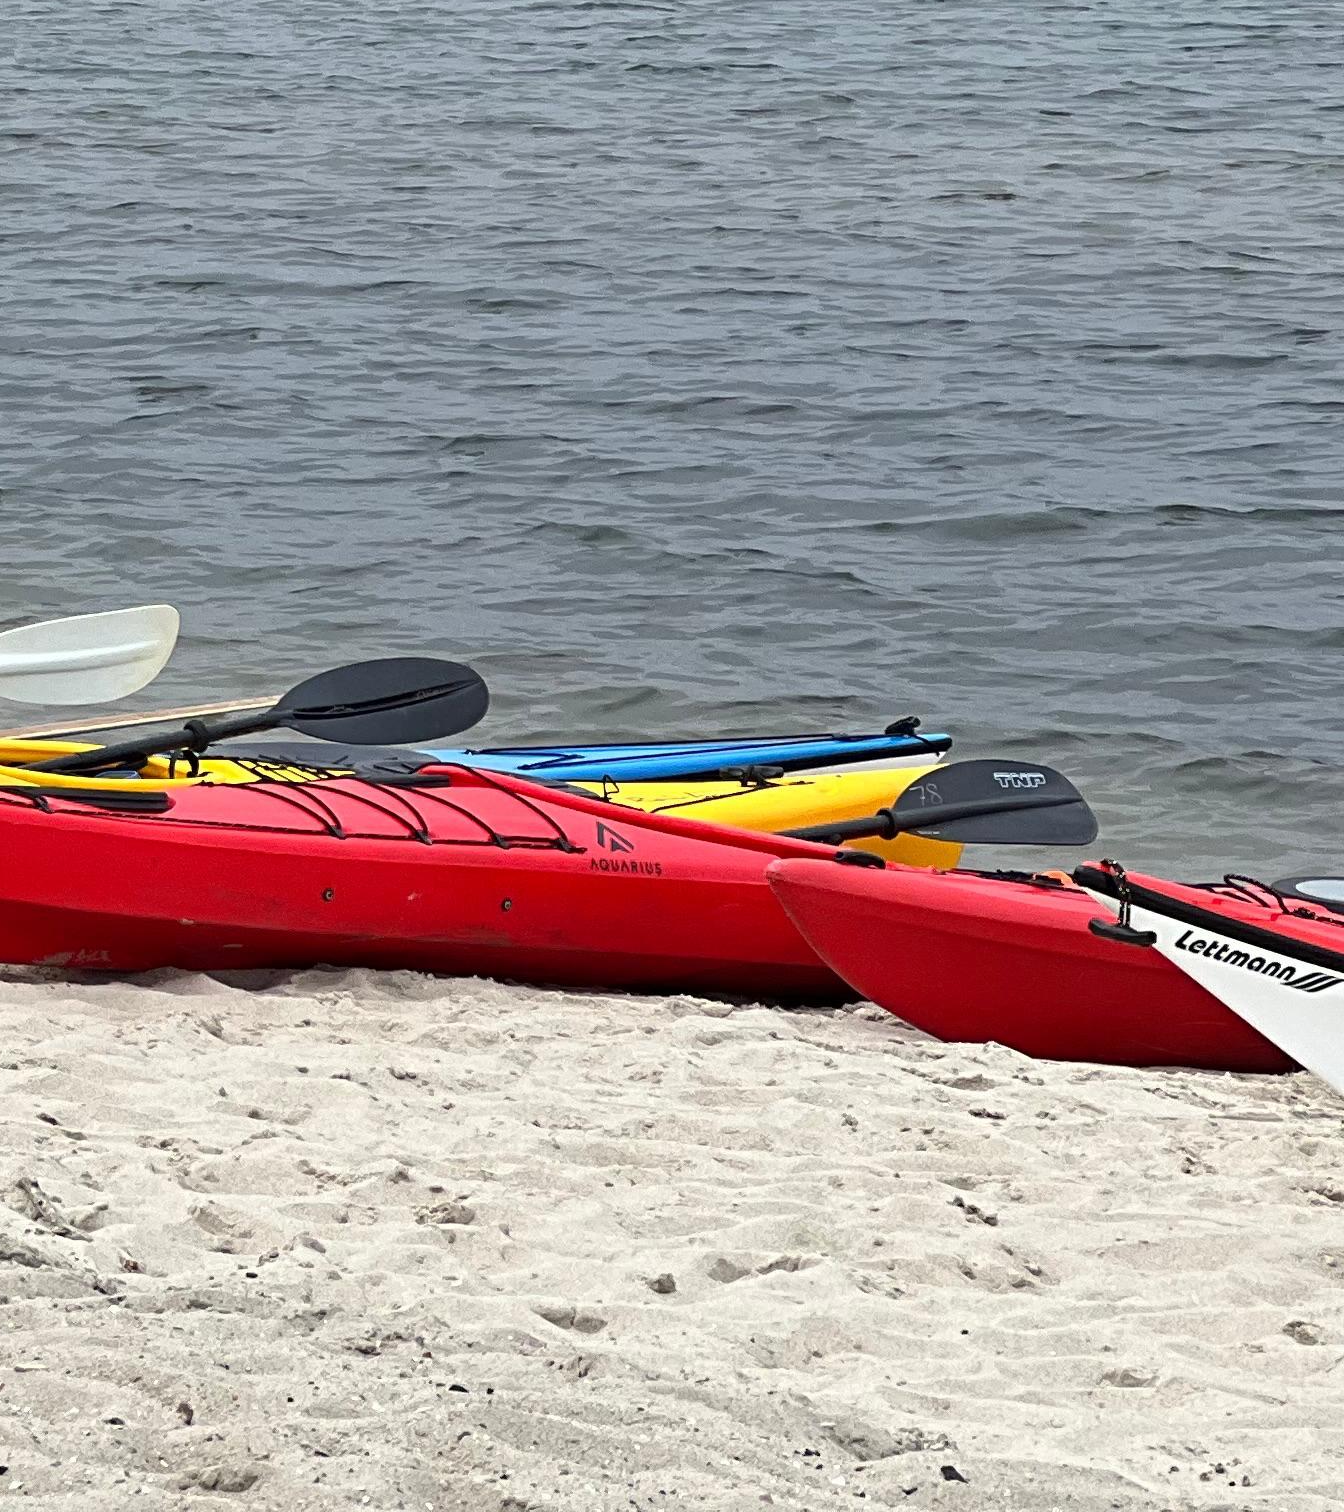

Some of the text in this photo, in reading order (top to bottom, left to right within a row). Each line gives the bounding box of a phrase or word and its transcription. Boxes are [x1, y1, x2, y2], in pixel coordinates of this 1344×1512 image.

[993, 772, 1046, 788] TNP
[909, 783, 943, 806] 78
[590, 857, 663, 876] AQUARIUS
[1174, 929, 1296, 982] Lettmann
